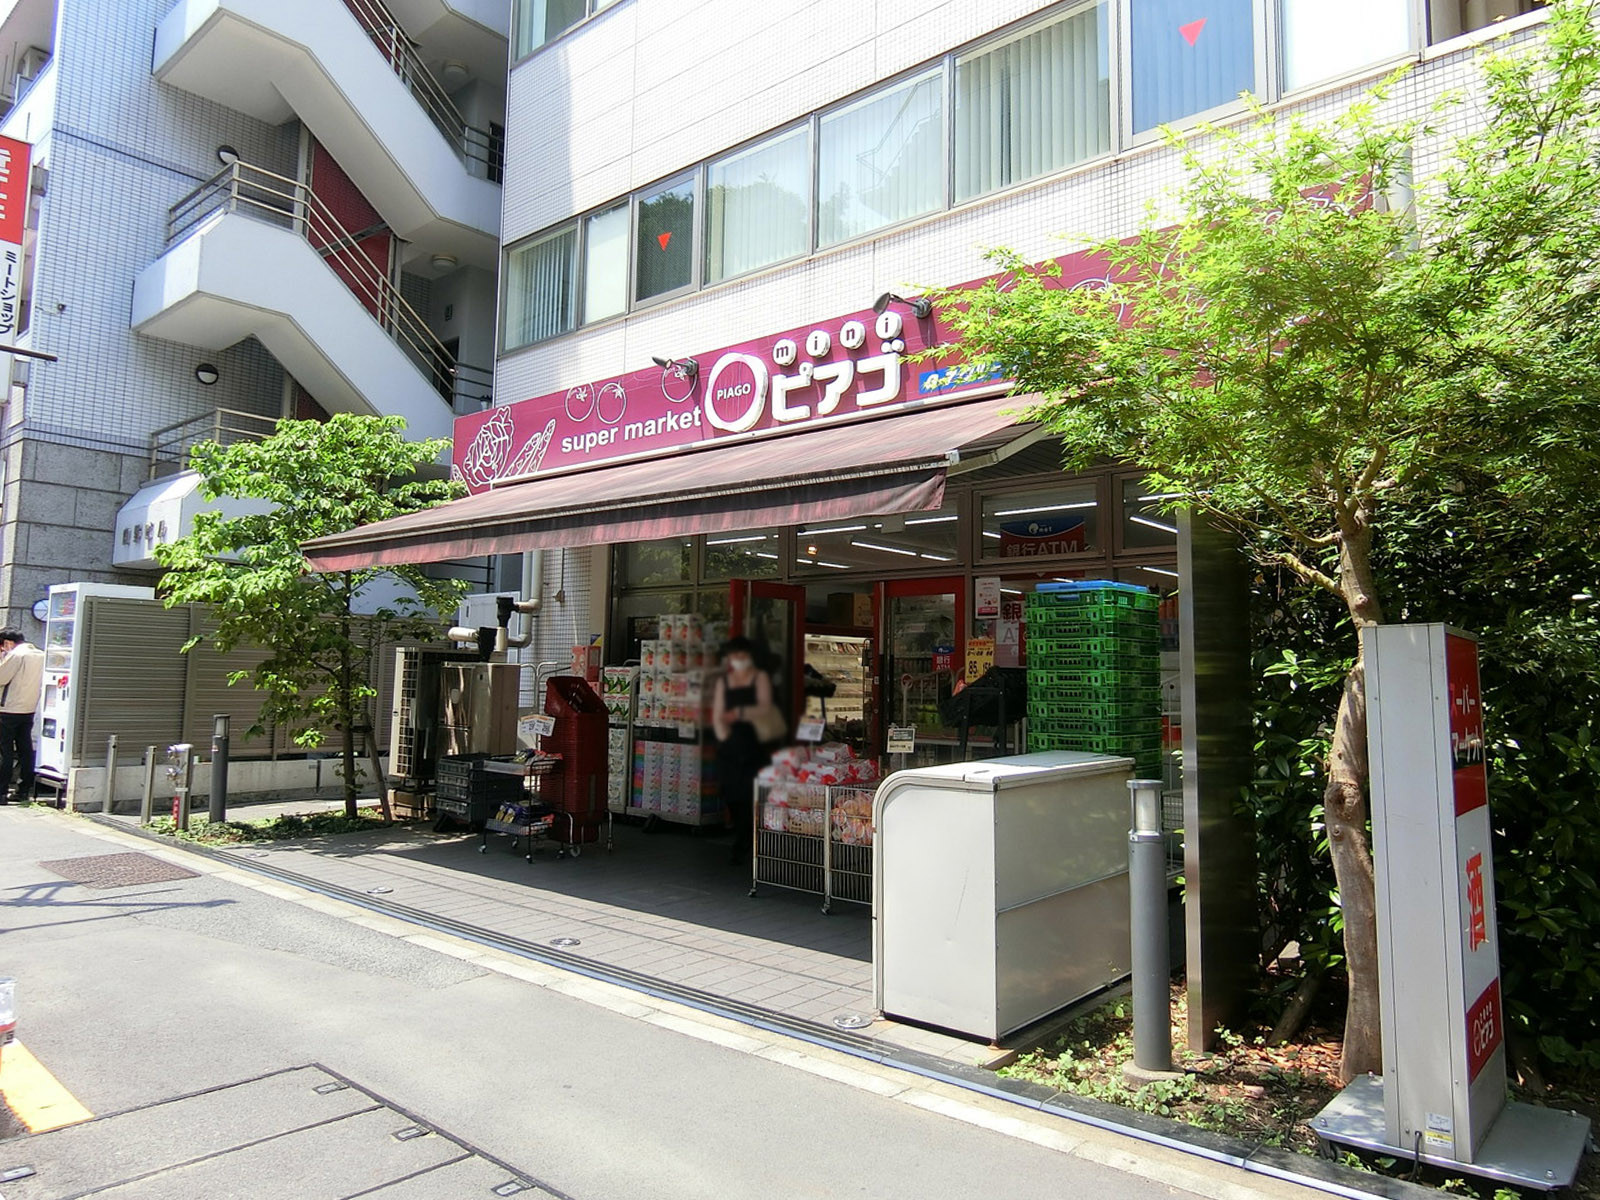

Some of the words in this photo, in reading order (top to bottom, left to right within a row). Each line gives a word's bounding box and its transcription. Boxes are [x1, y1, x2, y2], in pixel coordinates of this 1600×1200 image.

[774, 314, 896, 362] mini
[716, 382, 751, 401] PIAGO
[771, 338, 905, 421] ピアゴ
[561, 424, 619, 454] super
[624, 406, 702, 441] market
